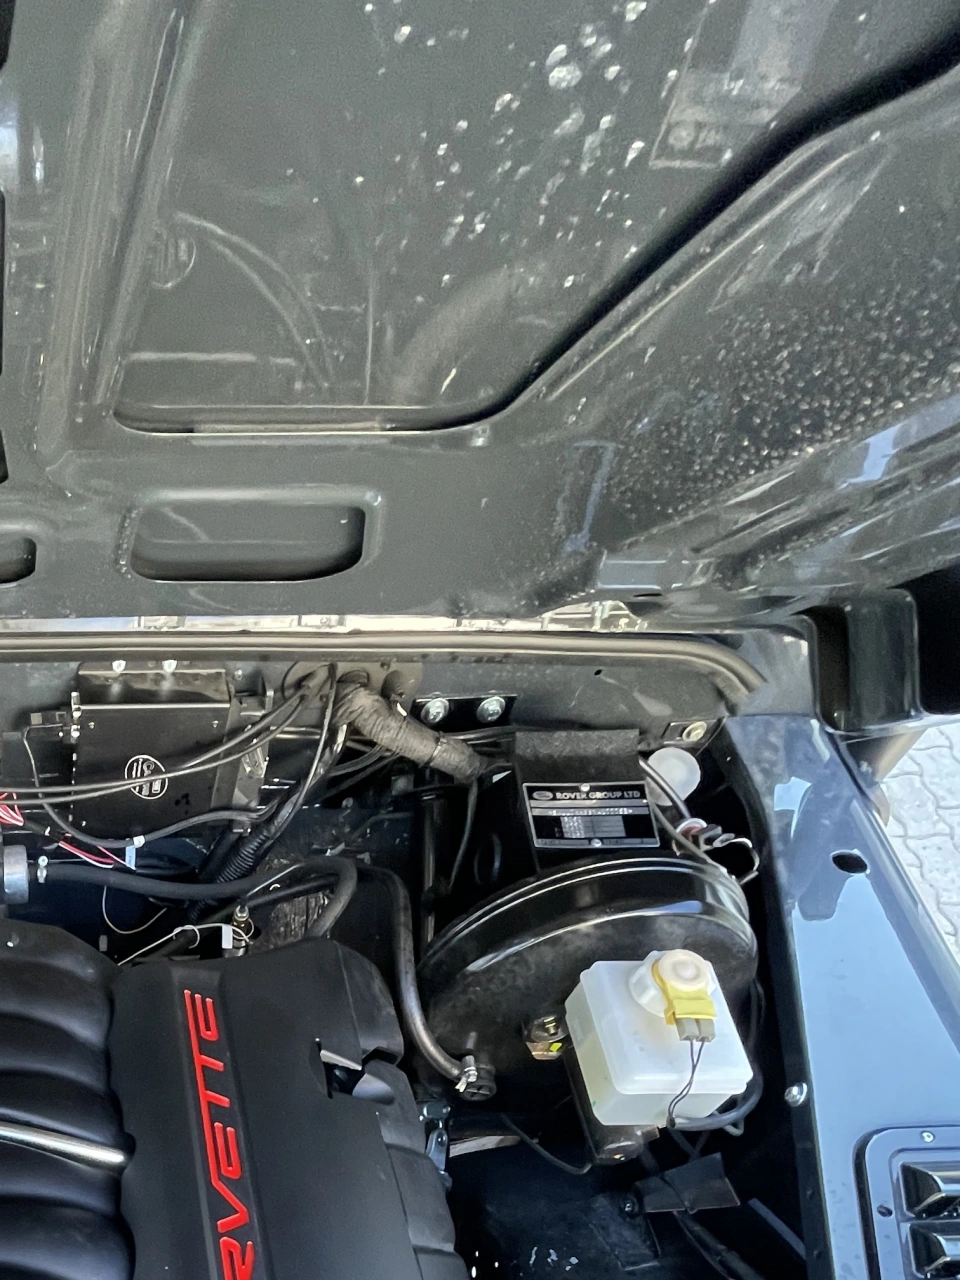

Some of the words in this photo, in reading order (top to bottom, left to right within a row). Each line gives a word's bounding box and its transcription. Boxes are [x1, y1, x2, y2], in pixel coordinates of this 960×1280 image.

[556, 792, 587, 800] ROVER
[589, 791, 622, 799] GROUP
[624, 790, 641, 798] LTD
